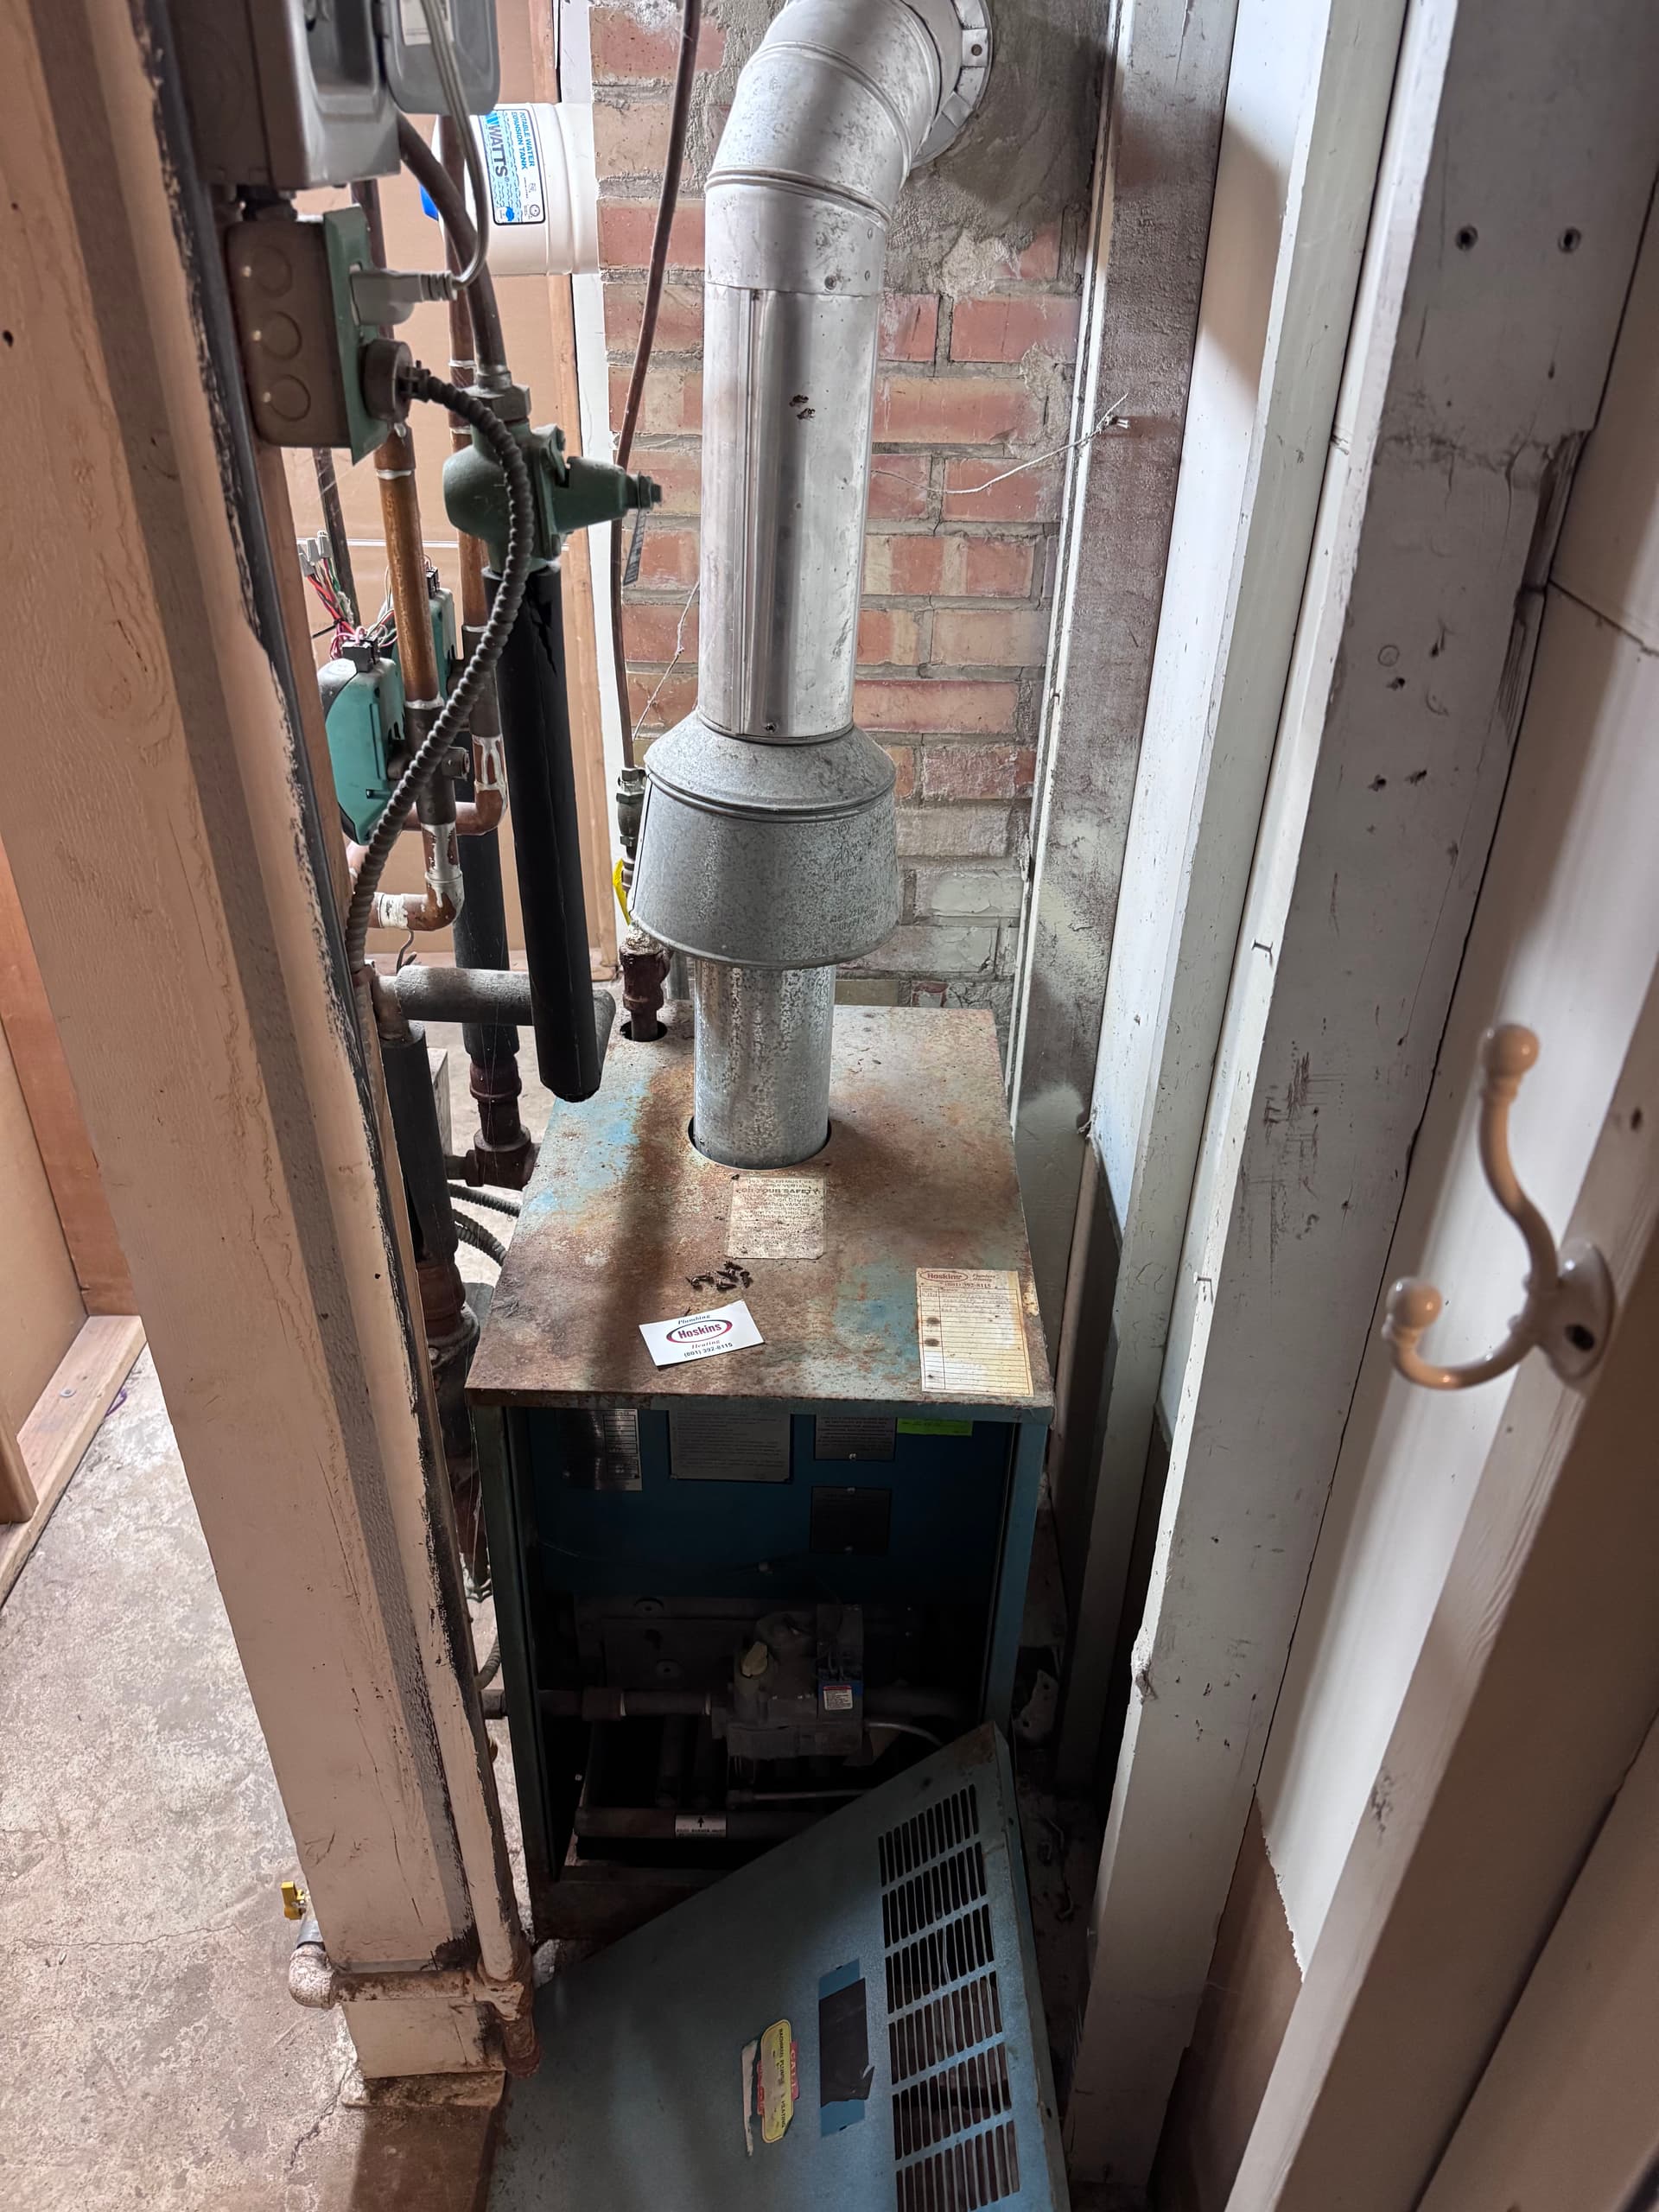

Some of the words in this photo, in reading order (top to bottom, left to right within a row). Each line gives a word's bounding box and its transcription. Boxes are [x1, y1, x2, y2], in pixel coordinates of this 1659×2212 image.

[488, 124, 508, 177] WATTS
[511, 111, 524, 146] EXPANSION
[518, 146, 528, 169] TANK
[519, 111, 531, 137] POTABLE
[525, 138, 535, 167] WATER
[677, 1324, 721, 1338] Hoskins
